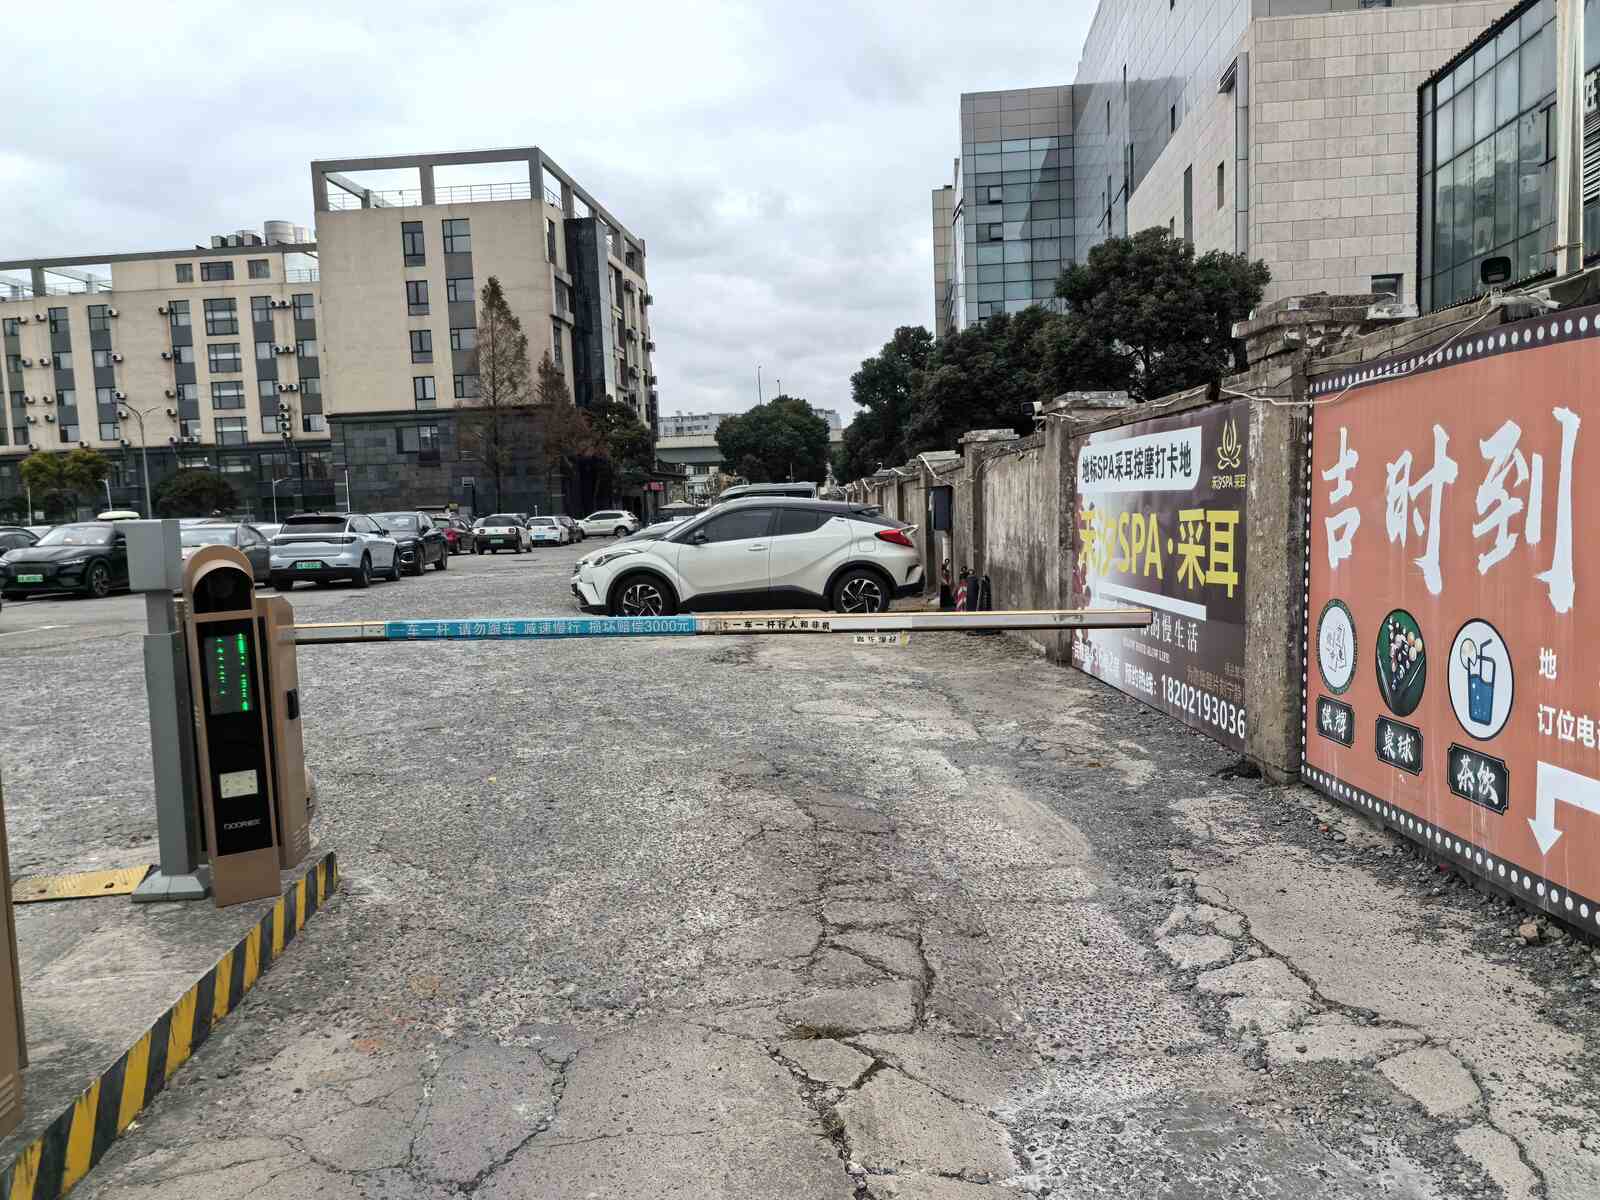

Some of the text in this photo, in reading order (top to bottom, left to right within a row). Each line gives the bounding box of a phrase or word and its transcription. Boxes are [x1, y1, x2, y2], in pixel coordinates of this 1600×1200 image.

[1082, 440, 1192, 483] 地标SPA采耳按摩打卡地
[1321, 407, 1580, 614] 吉时到
[1161, 674, 1246, 739] 18202193036
[1537, 703, 1600, 751] 订位电
[1382, 725, 1415, 763] 桌球
[1457, 754, 1499, 805] 茶饮
